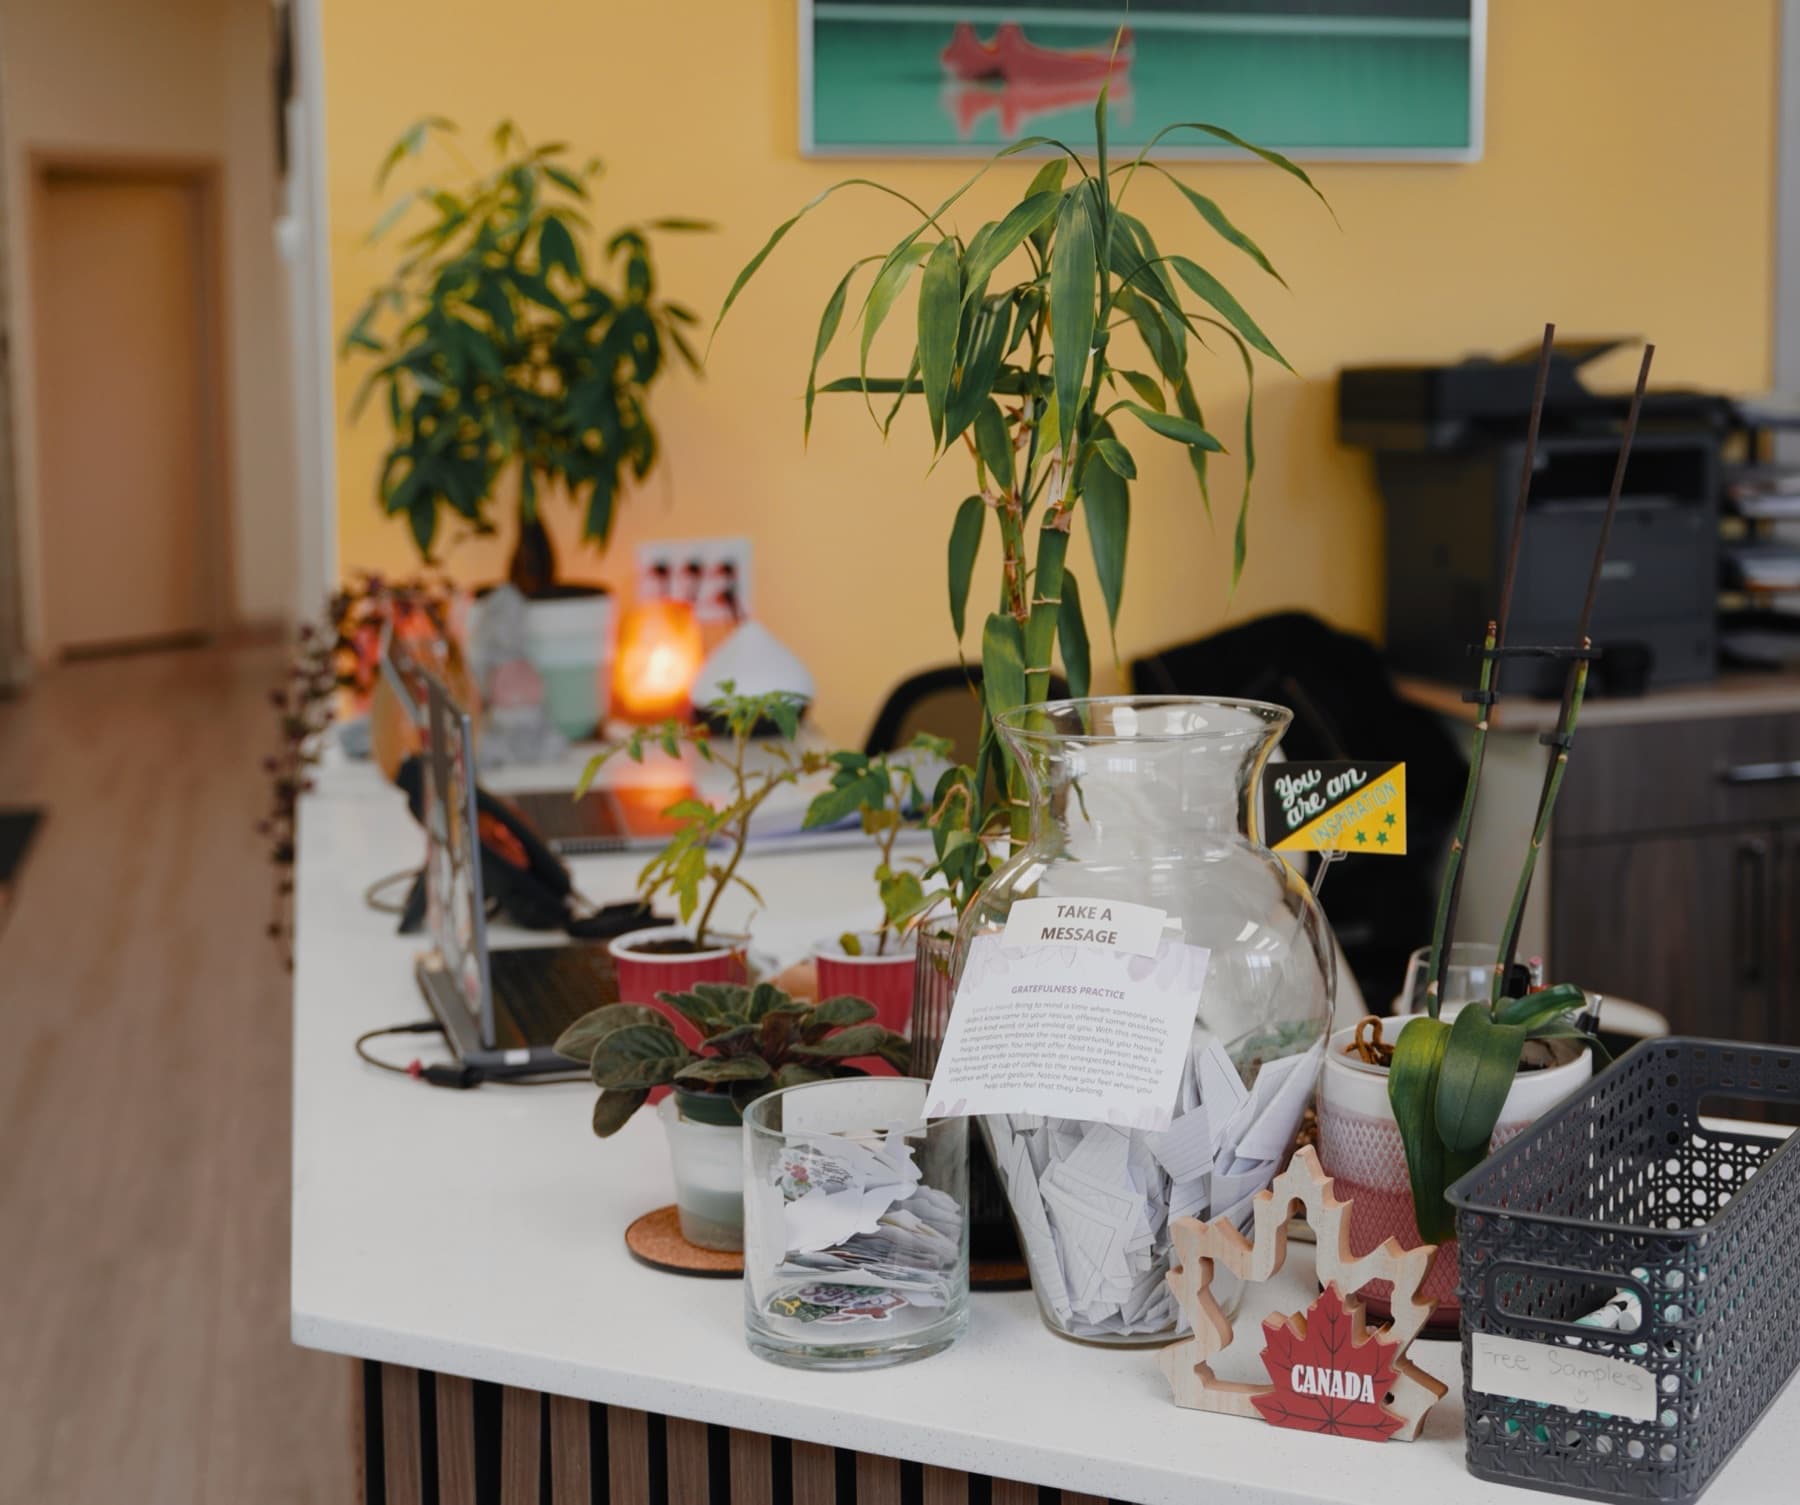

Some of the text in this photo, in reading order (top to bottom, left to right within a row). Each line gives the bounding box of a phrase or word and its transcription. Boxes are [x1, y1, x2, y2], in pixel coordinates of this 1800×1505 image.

[1274, 769, 1322, 808] You
[1286, 768, 1368, 829] are an
[1309, 778, 1399, 847] INSPIRATION
[1057, 905, 1113, 921] TAKE A
[1040, 927, 1118, 945] MESSAGE
[1011, 984, 1126, 1000] GRATEFULNESS PRACTICE
[1291, 1364, 1376, 1404] CANADA
[1548, 1350, 1644, 1391] Samples
